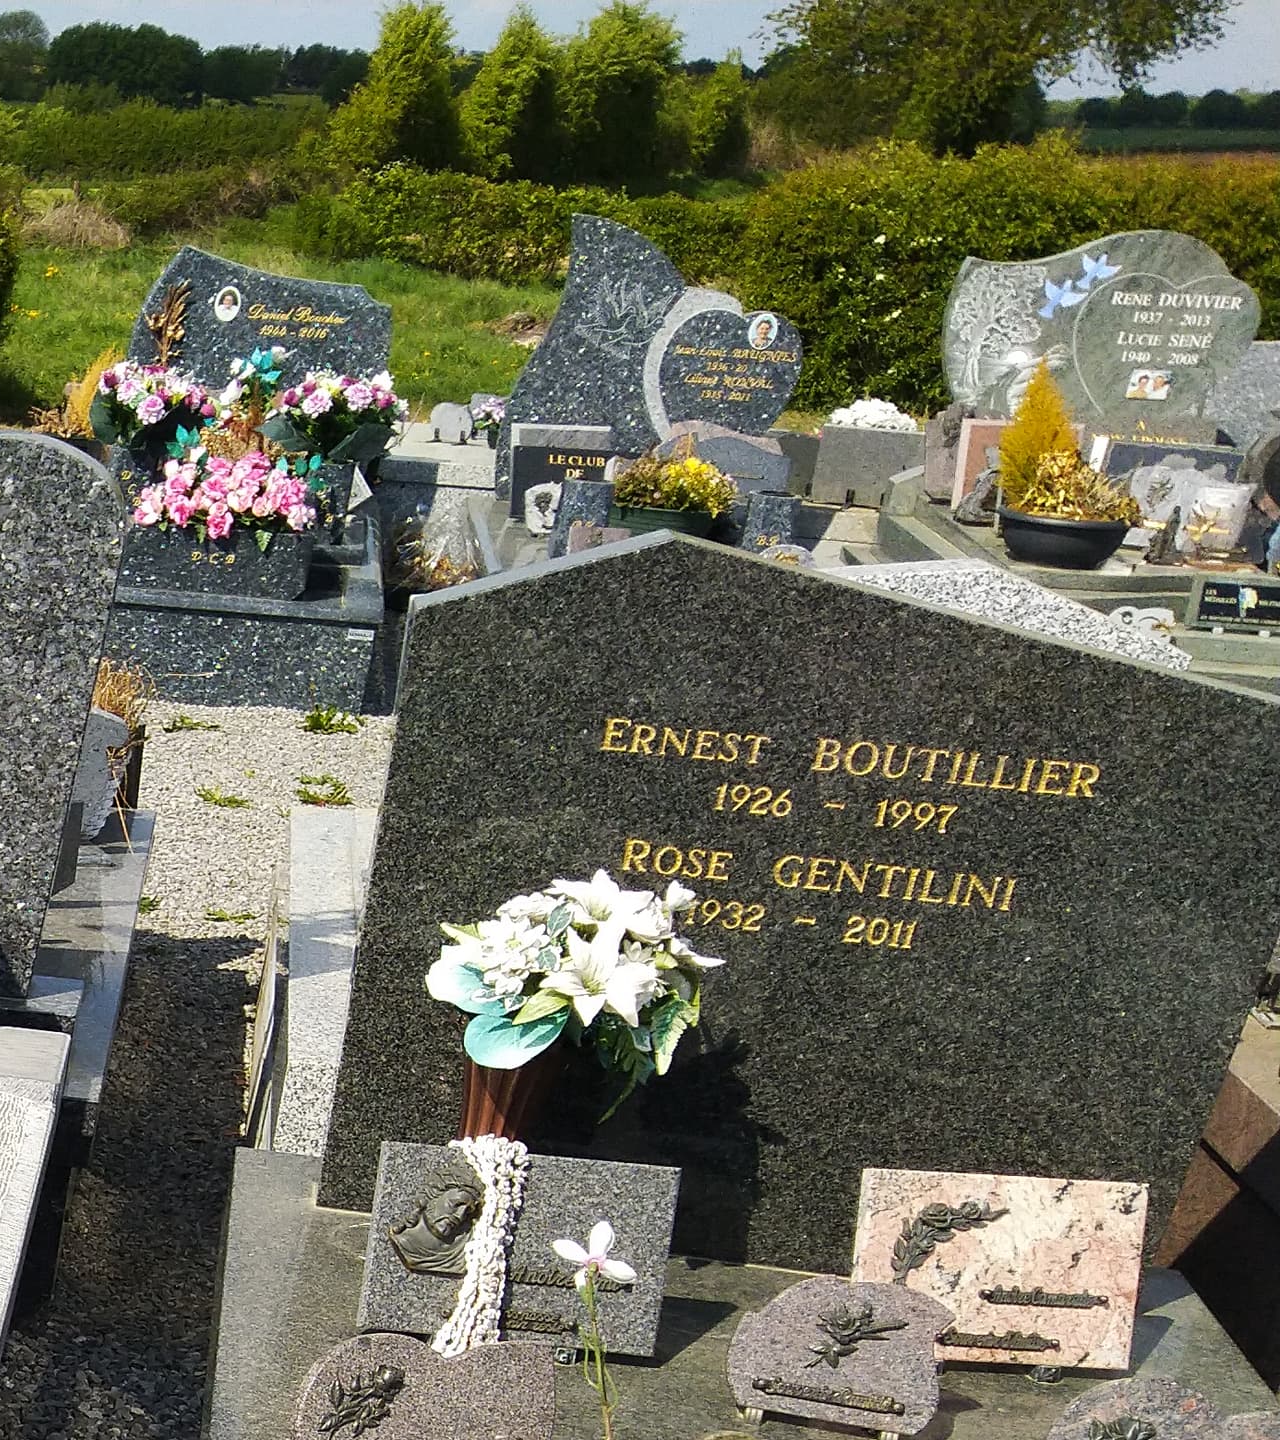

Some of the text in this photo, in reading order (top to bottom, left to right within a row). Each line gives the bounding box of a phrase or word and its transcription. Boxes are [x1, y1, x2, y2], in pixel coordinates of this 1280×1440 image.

[1159, 293, 1243, 310] DUVIVIER
[1134, 311, 1163, 324] 1937
[1180, 314, 1211, 327] 2013
[1117, 331, 1163, 346] LUCIE
[548, 454, 605, 468] LE CLUB
[600, 717, 1100, 798] ERNEST BOUTILLIER
[712, 782, 793, 818] 1926
[876, 799, 959, 834] 1997
[621, 839, 1017, 912] ROSE GENTILINI
[685, 899, 767, 932] 1932
[842, 916, 918, 949] 2011
